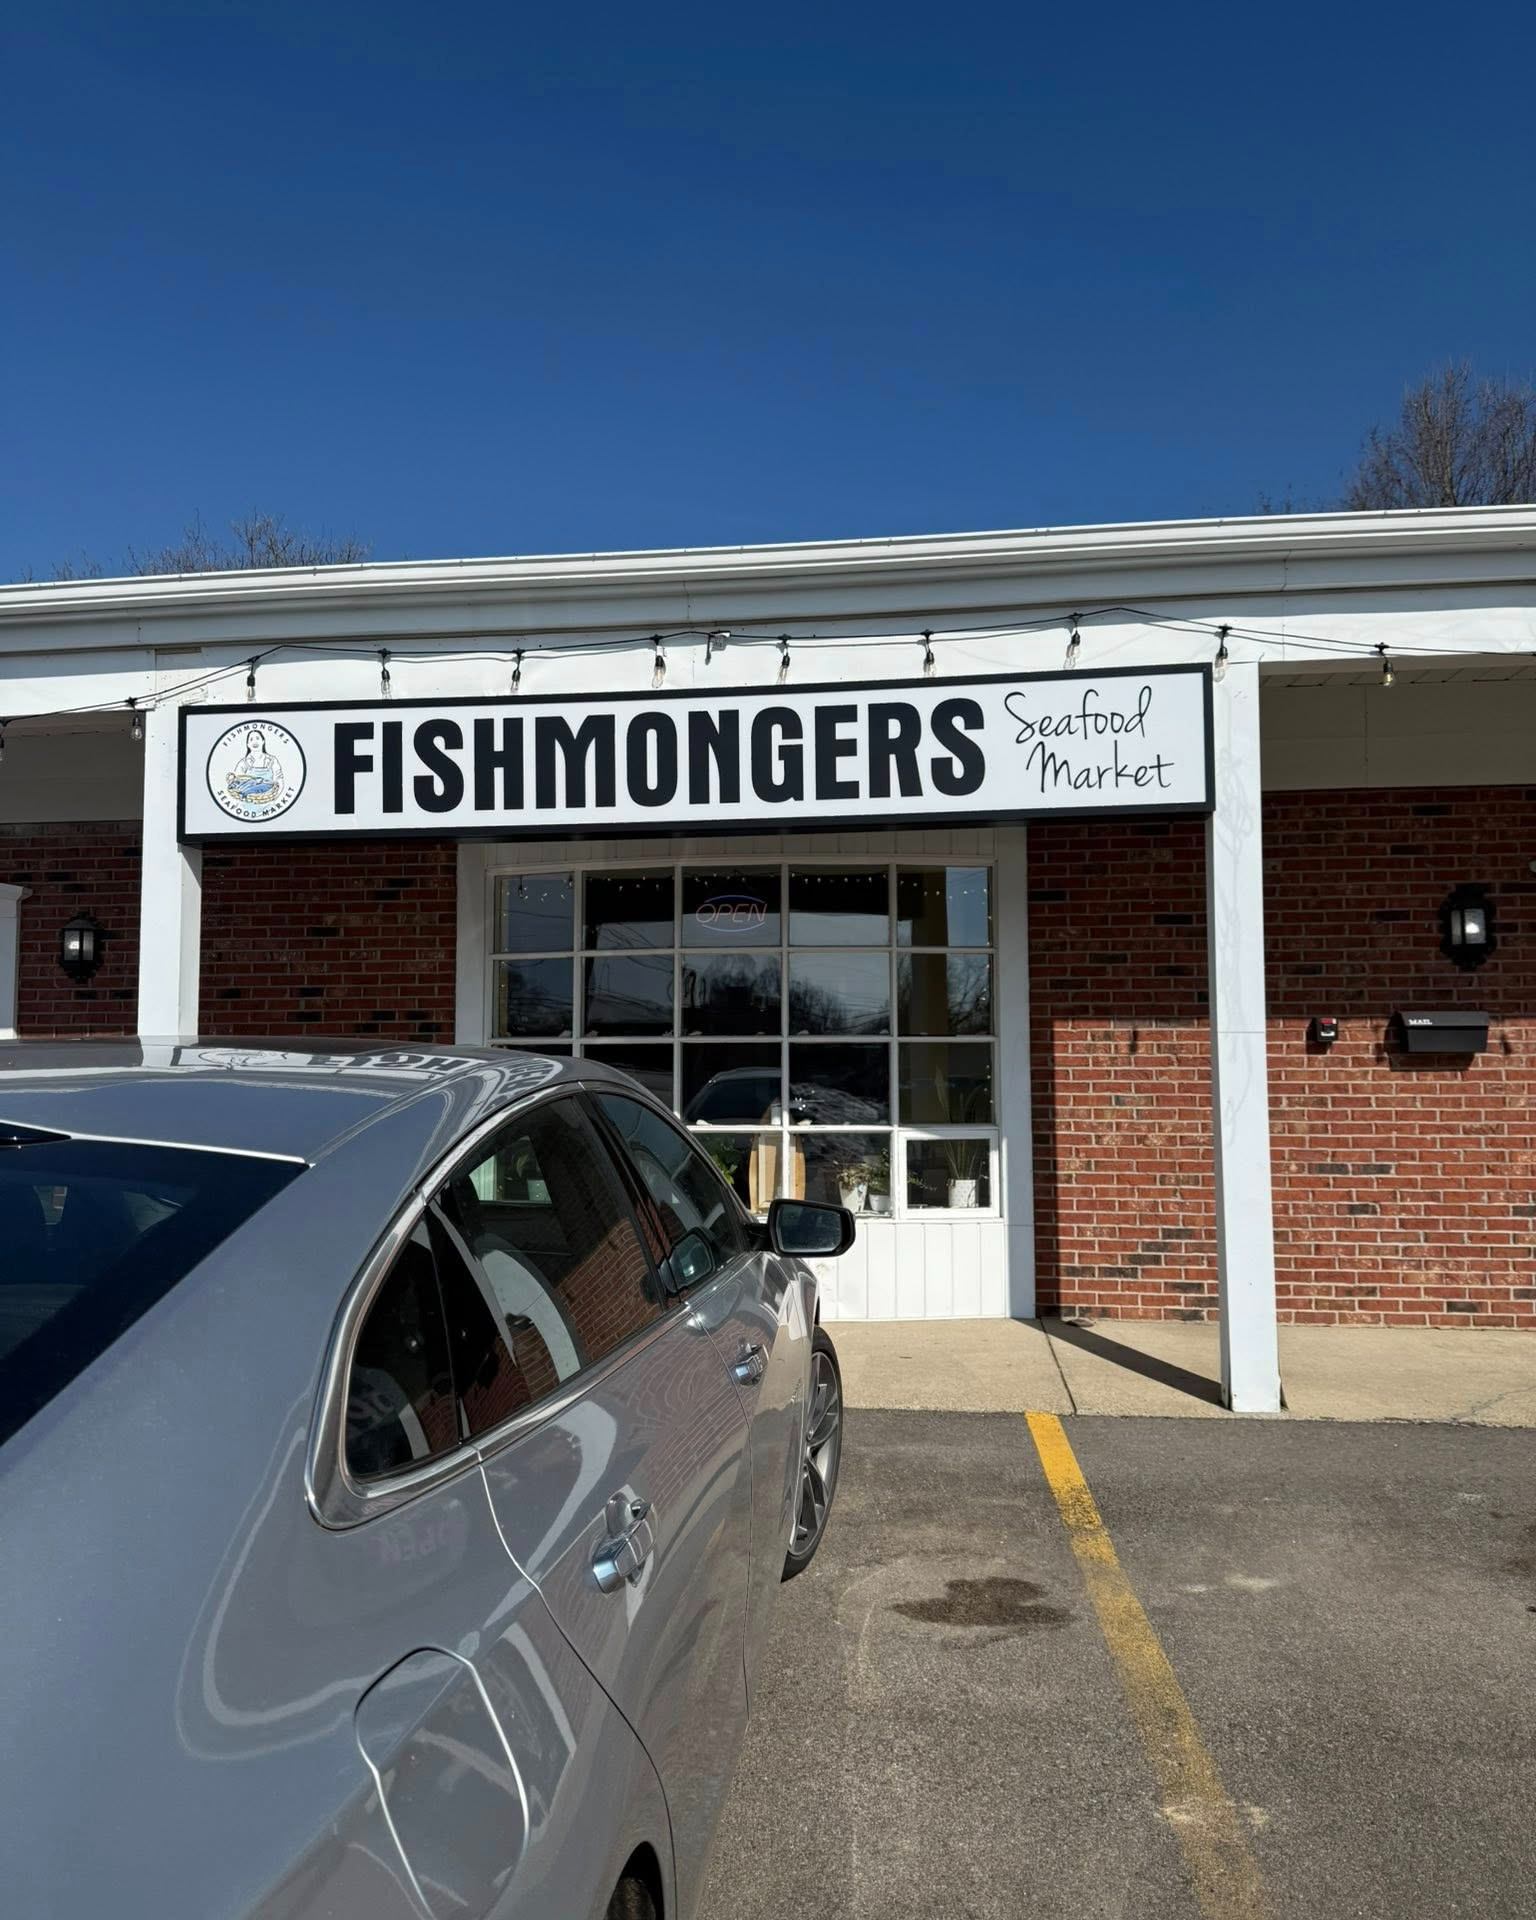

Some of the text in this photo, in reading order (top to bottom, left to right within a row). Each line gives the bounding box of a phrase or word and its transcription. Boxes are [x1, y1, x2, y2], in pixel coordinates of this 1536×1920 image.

[223, 724, 289, 746] FISHMONGERS
[1004, 685, 1152, 744] Seafood
[333, 697, 986, 815] FISHMONGERS
[1026, 739, 1175, 793] Market
[217, 787, 295, 818] SEAFOOD MARKET
[695, 903, 768, 923] OPEN
